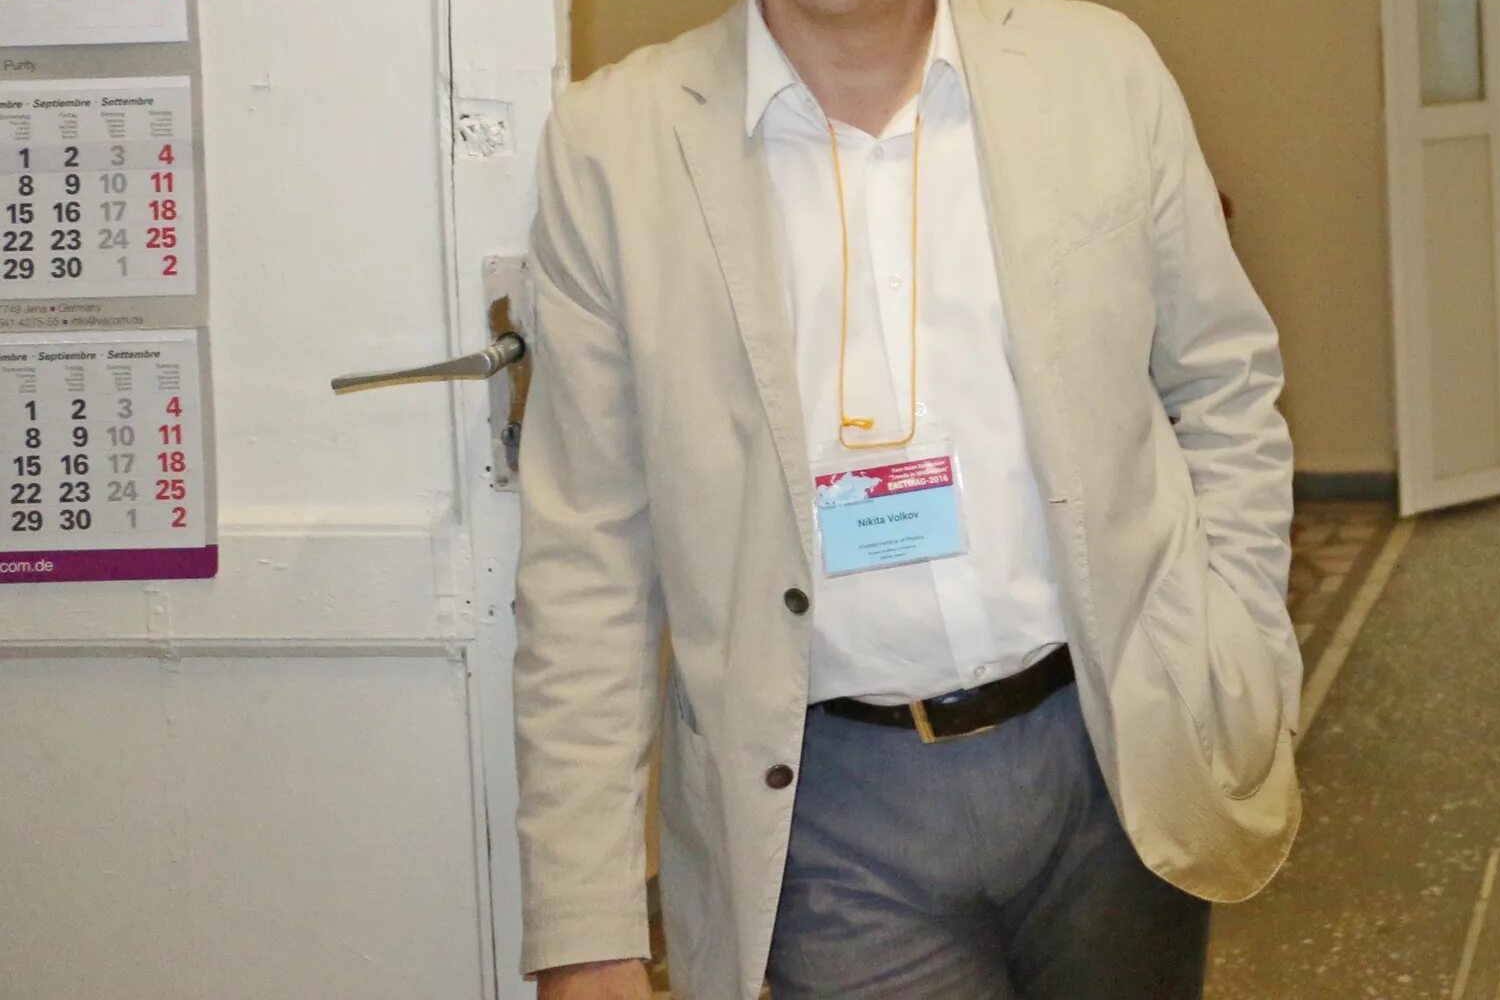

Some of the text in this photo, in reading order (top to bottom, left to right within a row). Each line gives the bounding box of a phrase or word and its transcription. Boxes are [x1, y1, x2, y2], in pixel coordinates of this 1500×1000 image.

[0, 97, 154, 109] mbre Septiembre Settembre
[19, 144, 174, 168] 1 2 3 4
[19, 172, 173, 196] 8 9 10 11
[7, 199, 176, 224] 15 16 17 18
[3, 227, 176, 251] 22 23 24 25
[3, 255, 177, 279] 29 30 1 2
[1, 349, 160, 361] mbre Septiembre Settembre
[25, 397, 182, 420] 1 2 3 4
[26, 424, 181, 448] 8 9 10 11
[14, 451, 185, 476] 15 16 17 18
[11, 479, 185, 504] 22 23 24 25
[12, 507, 186, 531] 29 30 1 2
[858, 511, 919, 527] Nikita Volkov
[0, 559, 54, 573] com.de
